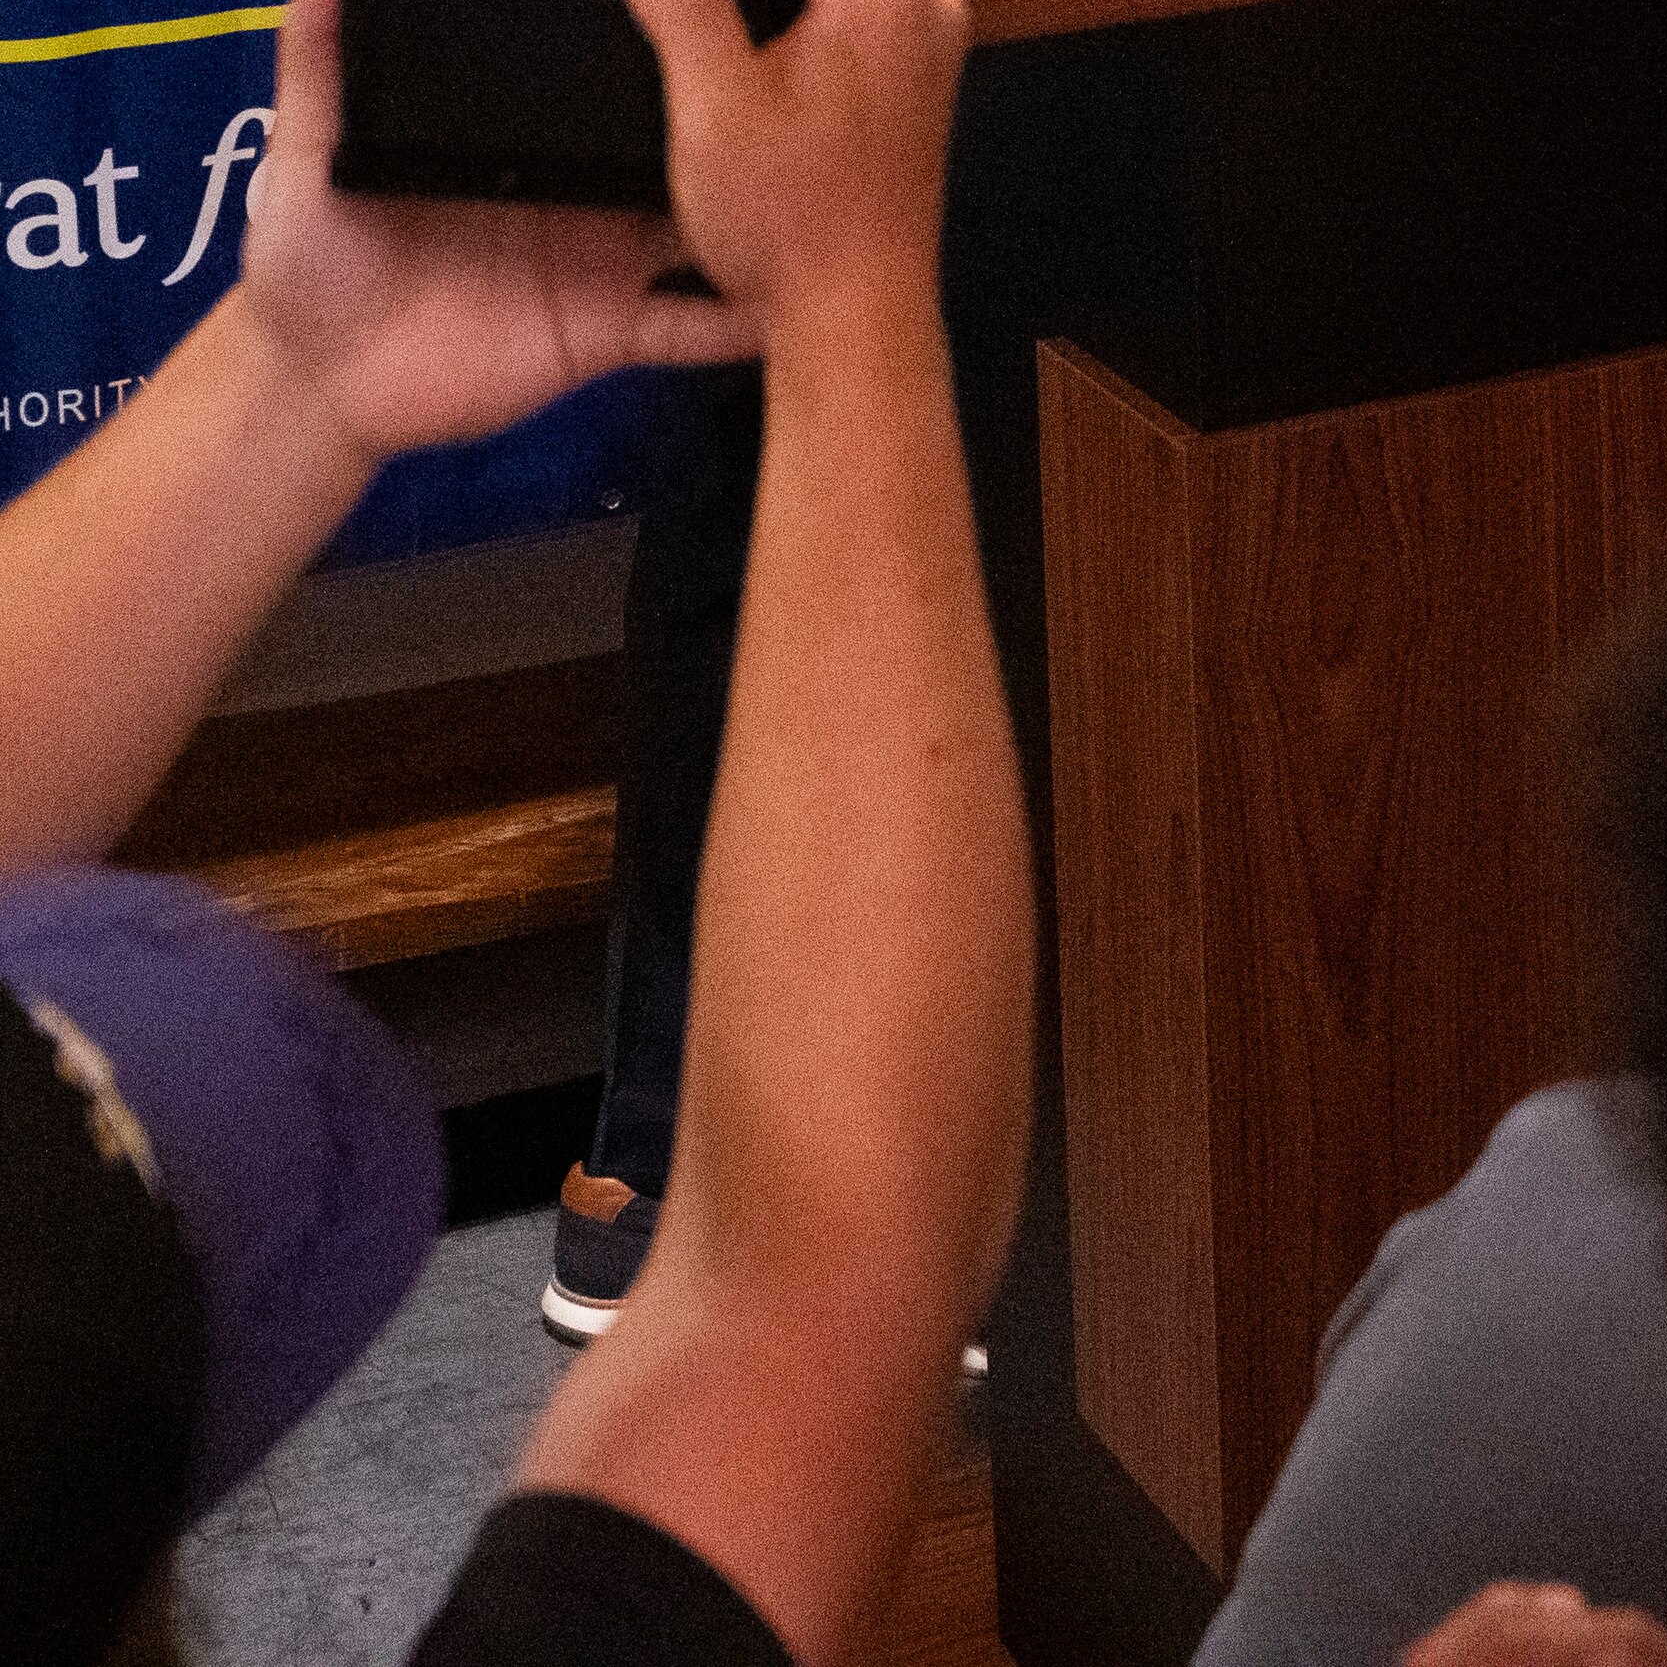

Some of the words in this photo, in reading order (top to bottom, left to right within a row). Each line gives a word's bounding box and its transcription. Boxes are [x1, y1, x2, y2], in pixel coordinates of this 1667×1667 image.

[0, 147, 147, 271] at
[161, 106, 278, 287] f
[0, 375, 152, 432] ORIT
